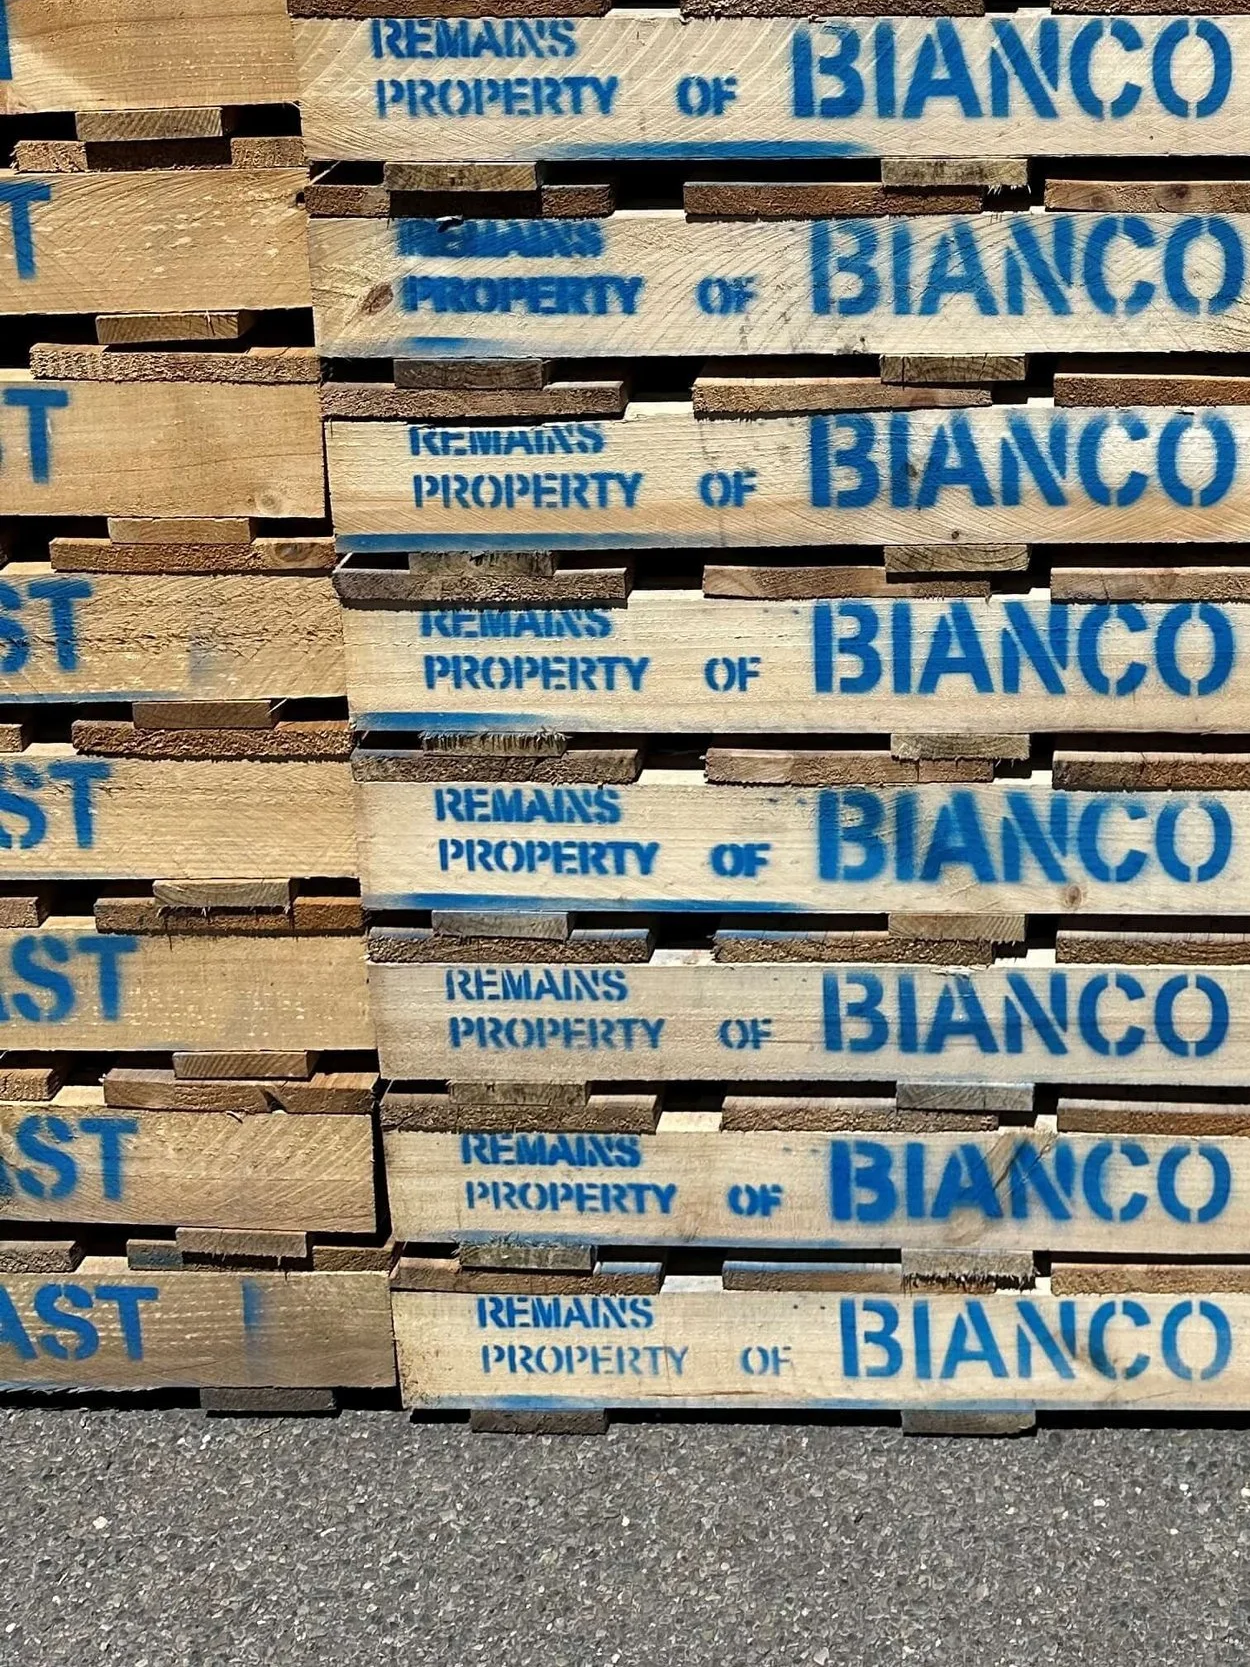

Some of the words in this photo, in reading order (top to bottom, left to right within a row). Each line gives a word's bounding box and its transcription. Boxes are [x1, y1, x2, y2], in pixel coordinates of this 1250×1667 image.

[371, 19, 577, 59] REMAINS
[376, 75, 619, 116] PROPERTY
[676, 77, 736, 116] OF
[790, 18, 1233, 120] BIANCO
[401, 274, 644, 316] PROPERTY
[695, 277, 755, 315] OF
[809, 216, 1247, 317] BIANCO
[409, 425, 605, 455] REMAINS
[413, 472, 642, 507] PROPERTY
[698, 471, 757, 506] OF
[809, 412, 1239, 509] BIANCO
[420, 609, 613, 638] REMAINS
[424, 655, 649, 690] PROPERTY
[704, 656, 761, 691] OF
[811, 600, 1237, 696] BIANCO
[435, 788, 621, 824] REMAINS
[439, 839, 660, 876] PROPERTY
[711, 844, 770, 877] OF
[816, 790, 1234, 884] BIANCO
[0, 935, 138, 1023] ST
[446, 970, 628, 1001] REMAINS
[449, 1016, 664, 1049] PROPERTY
[718, 1018, 772, 1050] OF
[822, 972, 1229, 1058] BIANCO
[0, 1115, 138, 1201] ST
[461, 1134, 642, 1167] REMAINS
[466, 1182, 676, 1214] PROPERTY
[727, 1185, 782, 1217] OF
[828, 1140, 1232, 1225] BIANCO
[477, 1296, 654, 1329] REMAINS
[481, 1344, 688, 1374] PROPERTY
[740, 1344, 792, 1374] OF
[839, 1298, 1232, 1380] BIANCO
